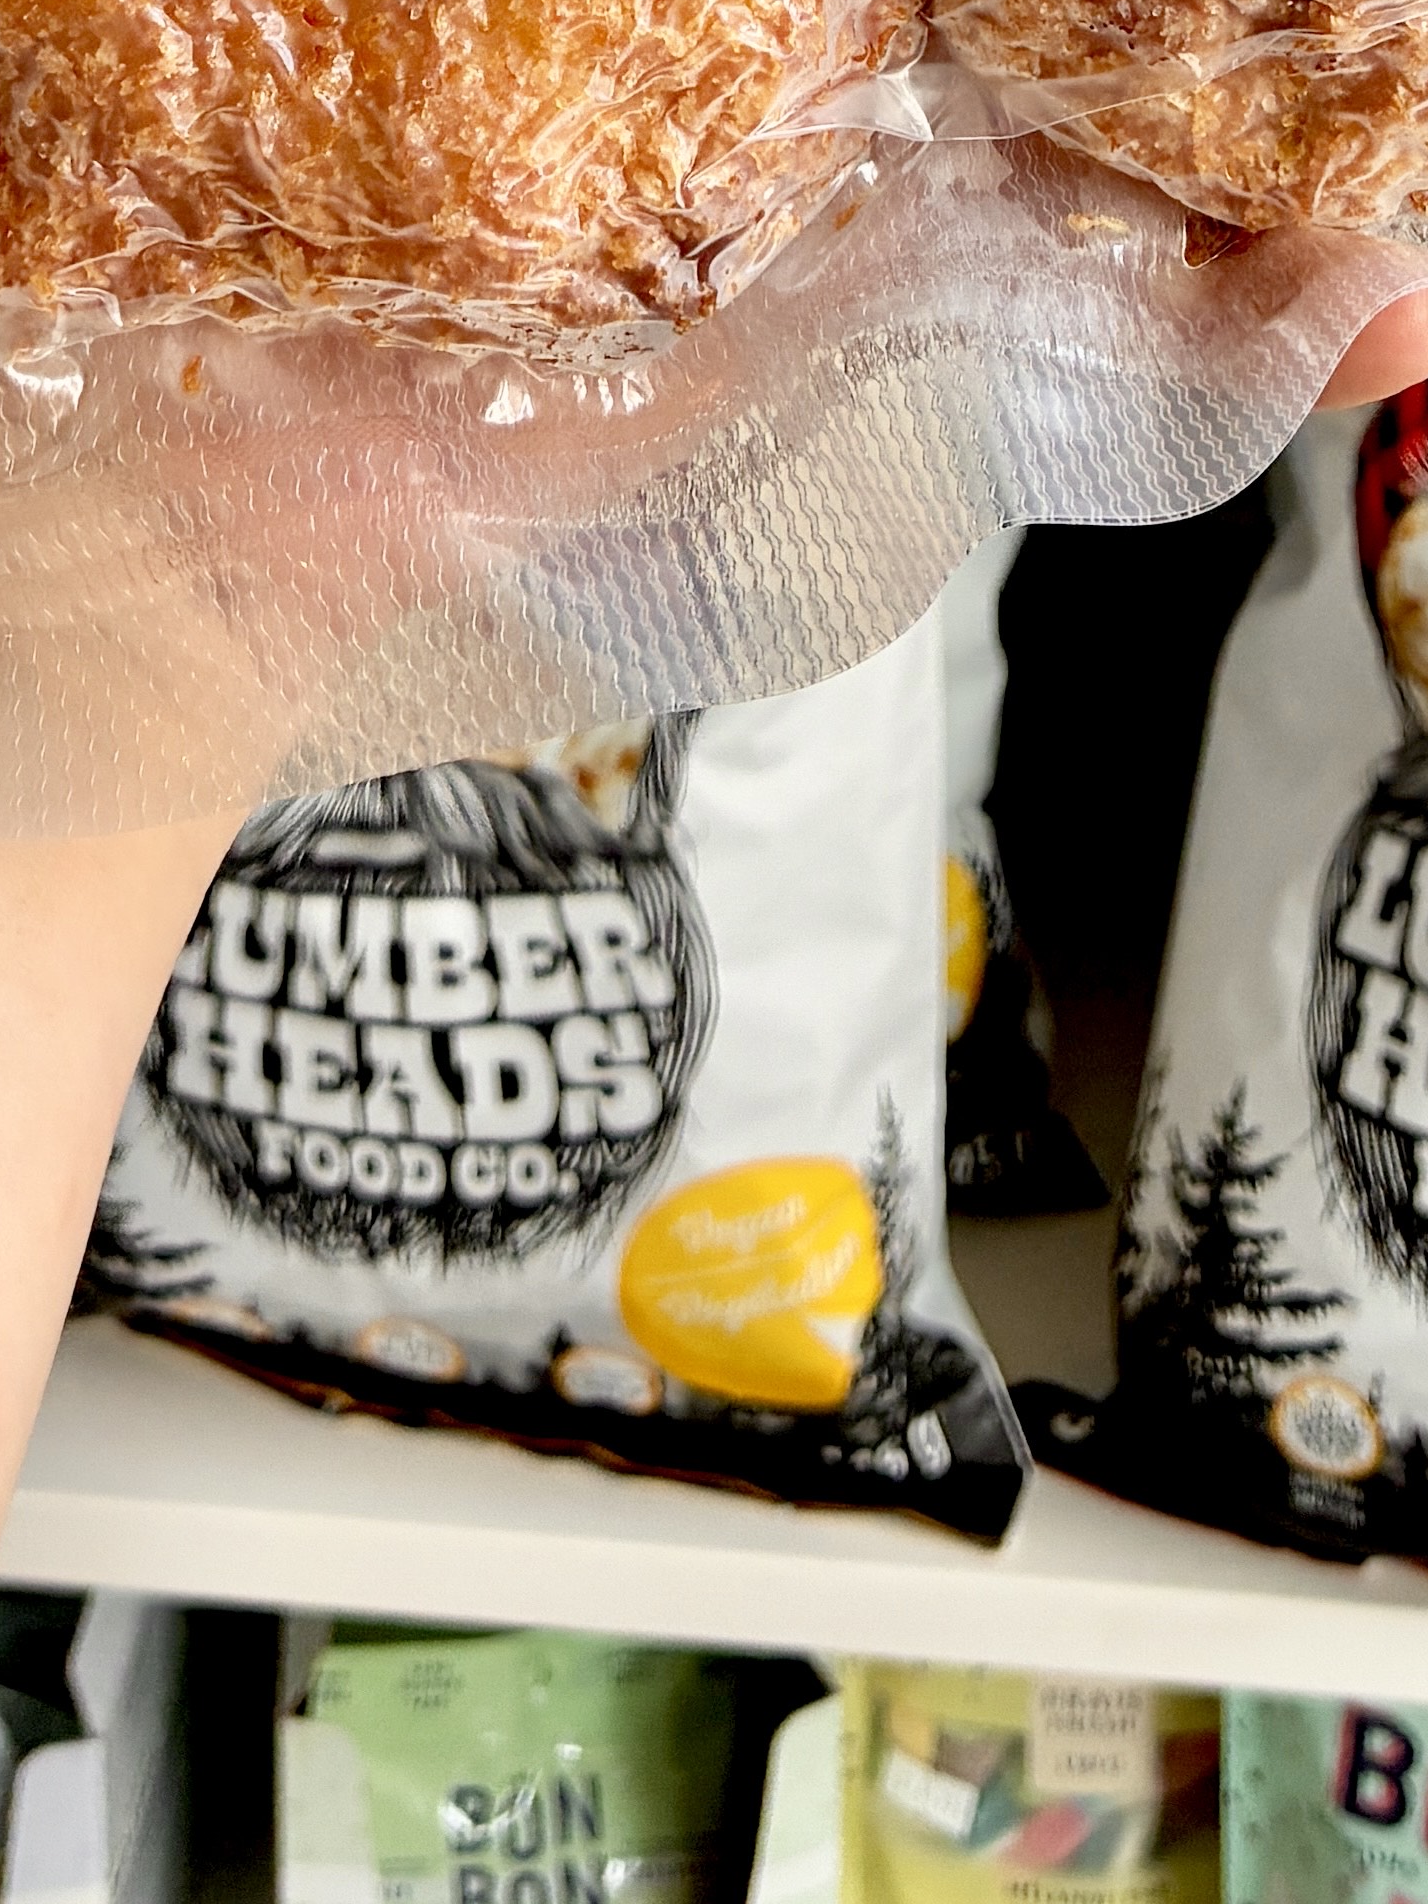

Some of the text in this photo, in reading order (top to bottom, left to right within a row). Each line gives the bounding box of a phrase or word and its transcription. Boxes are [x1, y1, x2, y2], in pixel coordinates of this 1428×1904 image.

[179, 877, 680, 1026] UMBER
[170, 988, 666, 1147] HEADS
[257, 1118, 447, 1202] FOOD
